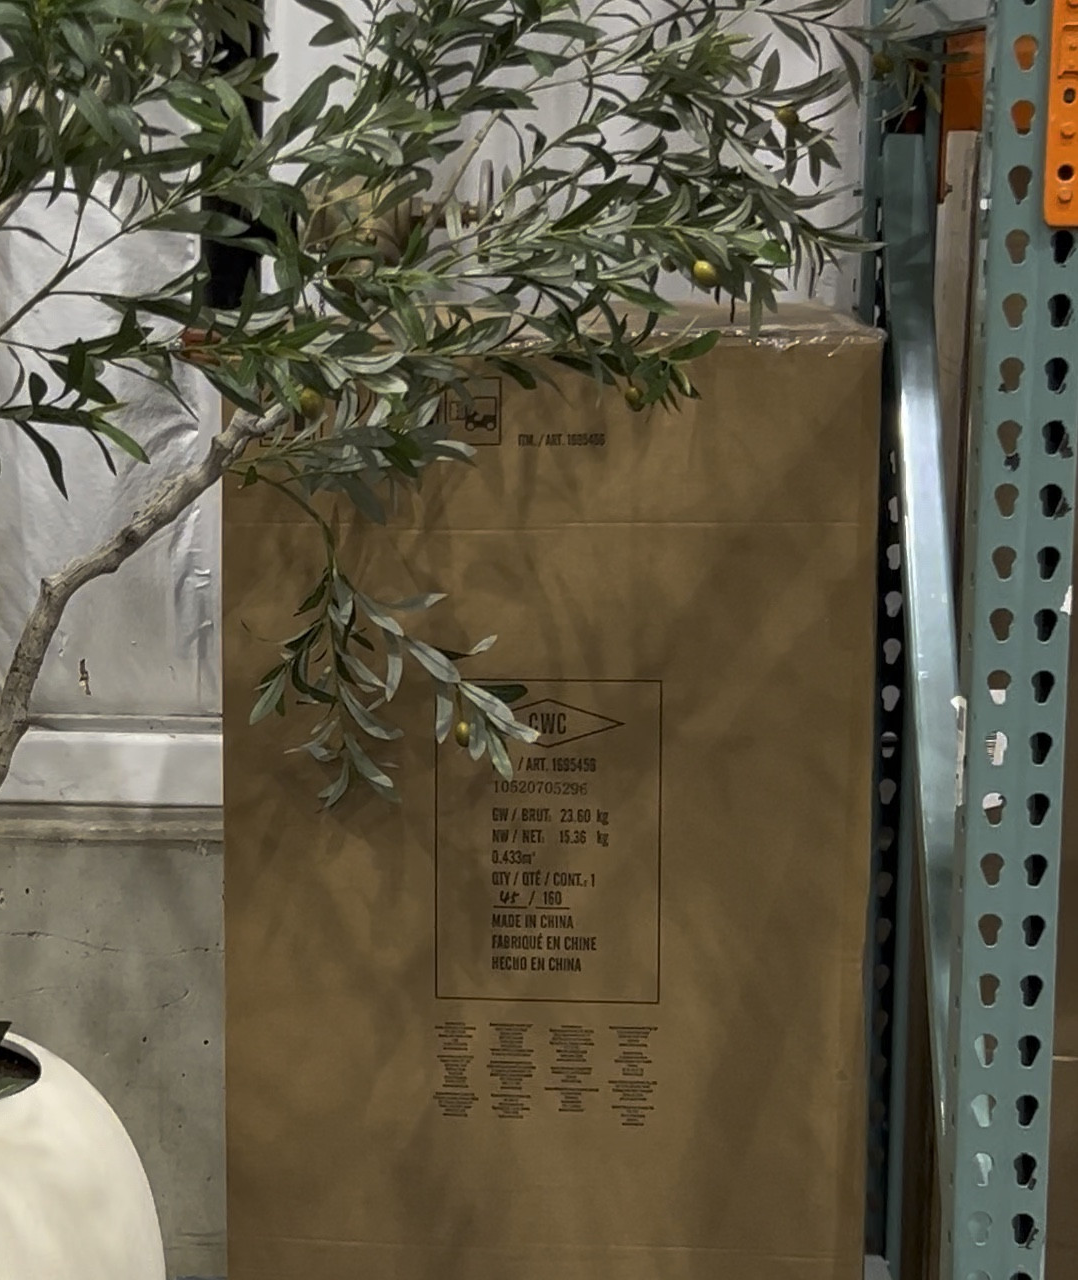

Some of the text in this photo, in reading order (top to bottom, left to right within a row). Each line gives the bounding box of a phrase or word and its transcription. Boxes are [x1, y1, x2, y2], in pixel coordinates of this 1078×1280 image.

[596, 809, 609, 826] kg
[596, 830, 609, 847] kg
[492, 871, 511, 886] QTY
[543, 891, 563, 906] 160
[492, 913, 574, 929] MADE IN CHINA
[492, 932, 597, 951] FABRIQUÉ EN CHINE
[531, 956, 545, 971] EN
[548, 957, 582, 972] CHINA
